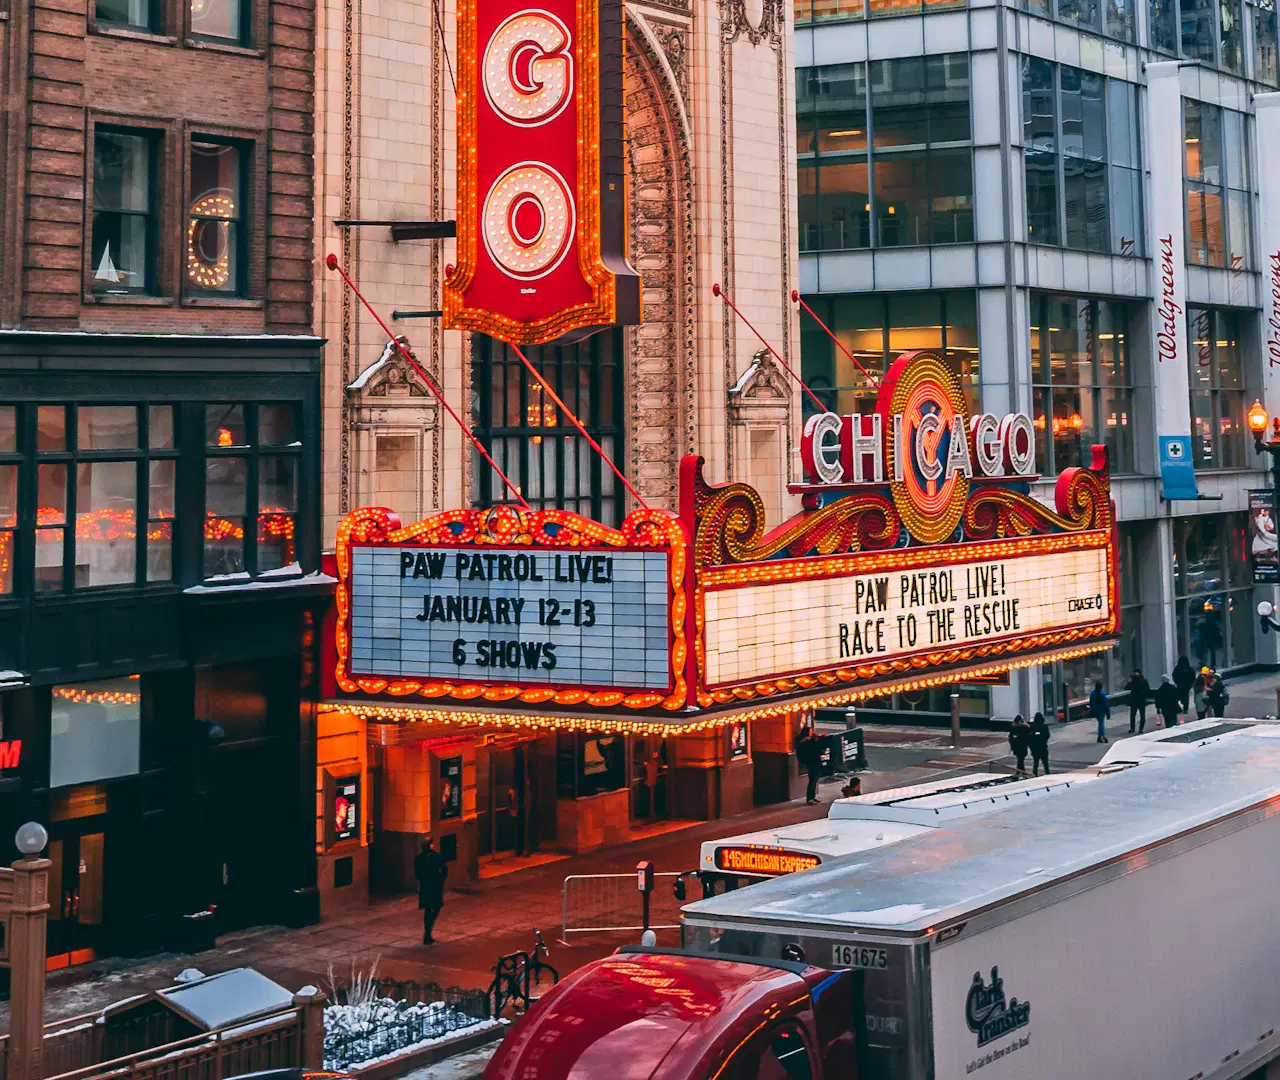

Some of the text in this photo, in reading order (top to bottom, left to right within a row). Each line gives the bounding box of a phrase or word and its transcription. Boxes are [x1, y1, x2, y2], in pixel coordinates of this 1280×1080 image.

[1158, 233, 1182, 363] Walgreens
[811, 411, 1036, 484] CHICAGO
[400, 551, 613, 584] PAW PATROL LIVE!
[855, 563, 1006, 614] PAW PATROL LIVE!
[1068, 596, 1095, 612] CHASE
[416, 594, 596, 628] JANUARY 12-13
[838, 598, 1020, 658] RACE TO THE RESCUE
[452, 638, 557, 670] 6 SHOWS
[722, 850, 740, 868] 146
[740, 852, 780, 871] MICHIGAN
[834, 946, 887, 968] 161675
